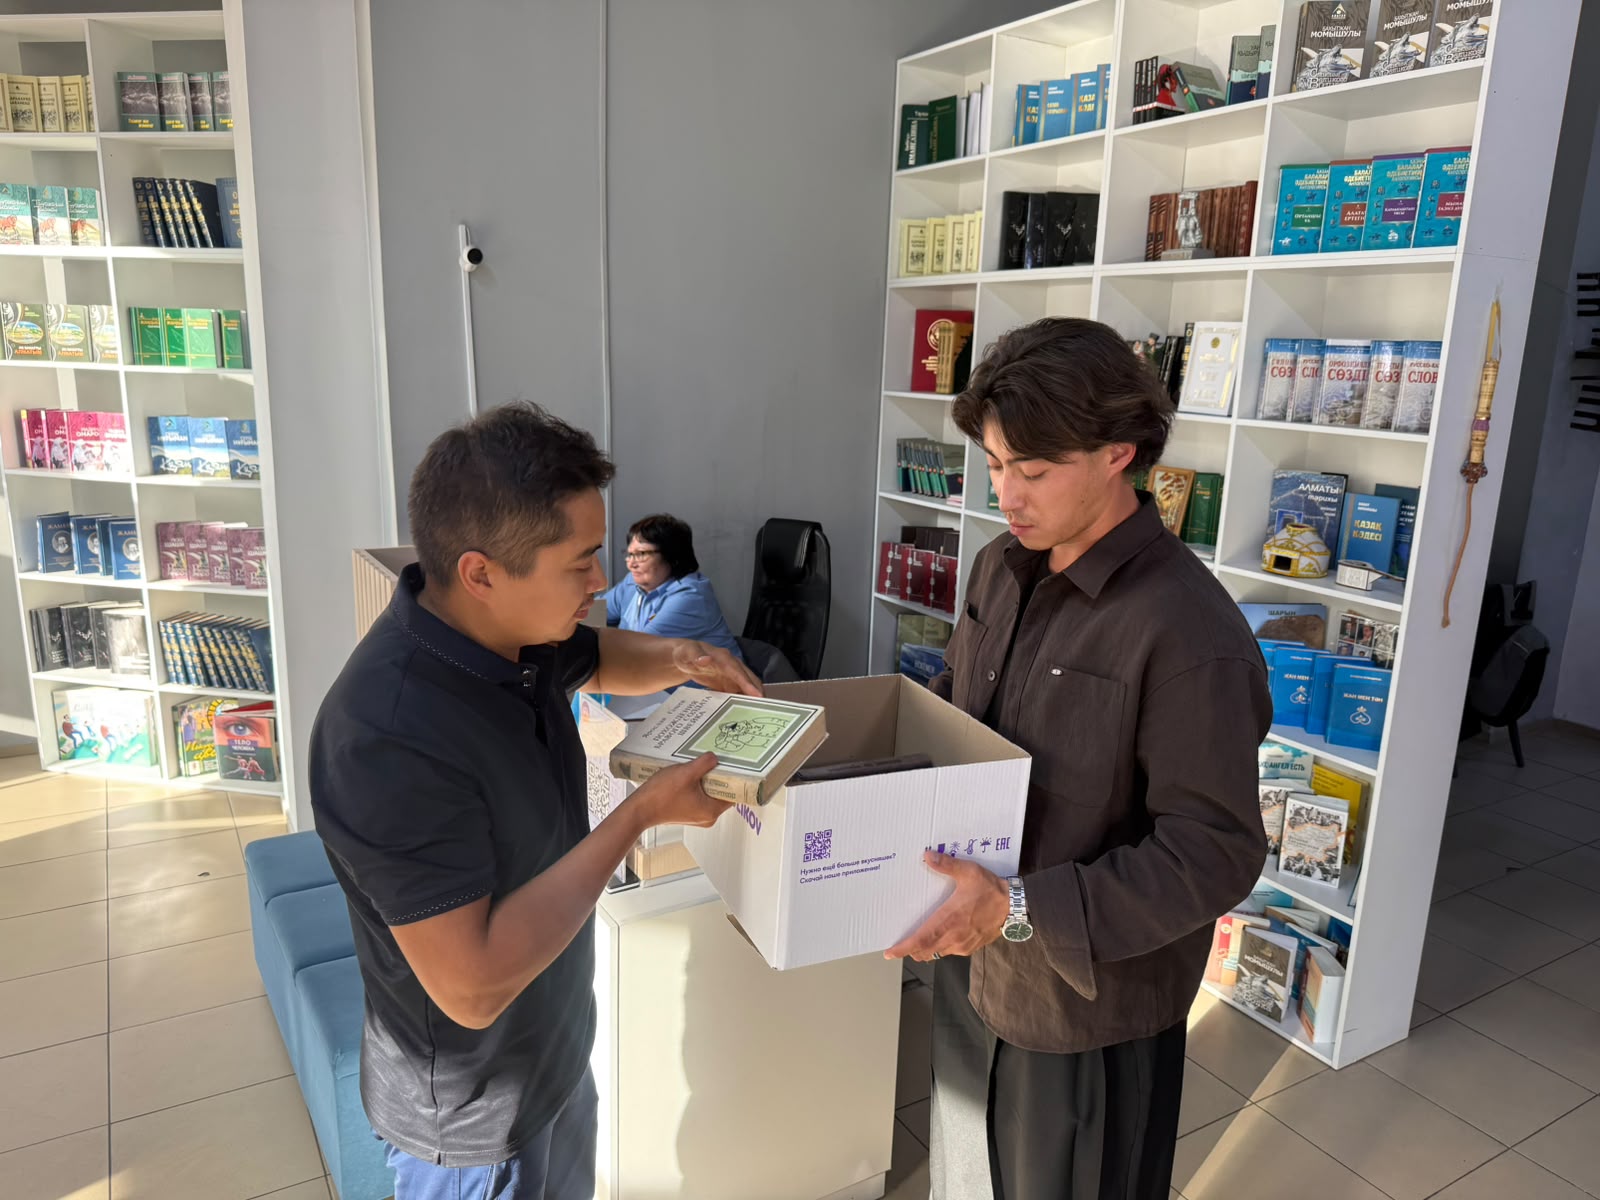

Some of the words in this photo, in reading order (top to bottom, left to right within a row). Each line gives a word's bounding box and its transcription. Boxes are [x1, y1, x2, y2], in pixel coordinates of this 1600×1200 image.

[1383, 14, 1428, 31] МОМЫШУЛЫ
[1310, 30, 1362, 38] МОМЫШУЛЫ
[1298, 483, 1339, 495] АЛМАТЫ
[1307, 494, 1338, 503] тарихы
[1268, 609, 1296, 617] ШАРЫН
[642, 717, 667, 738] Ярослав
[653, 700, 698, 742] ПОХОЖДЕНИЯ
[654, 722, 684, 749] БРАВОГО
[683, 695, 713, 722] СОЛДАТА
[677, 710, 706, 737] ШВЕЙКА
[1290, 763, 1305, 771] ЕСТЬ
[800, 867, 822, 876] Нужно
[822, 864, 836, 873] ещё
[836, 860, 860, 869] больше
[860, 852, 897, 865] вкусняшек?
[799, 874, 824, 884] Скачай
[824, 872, 841, 880] наше
[841, 864, 881, 877] приложение!
